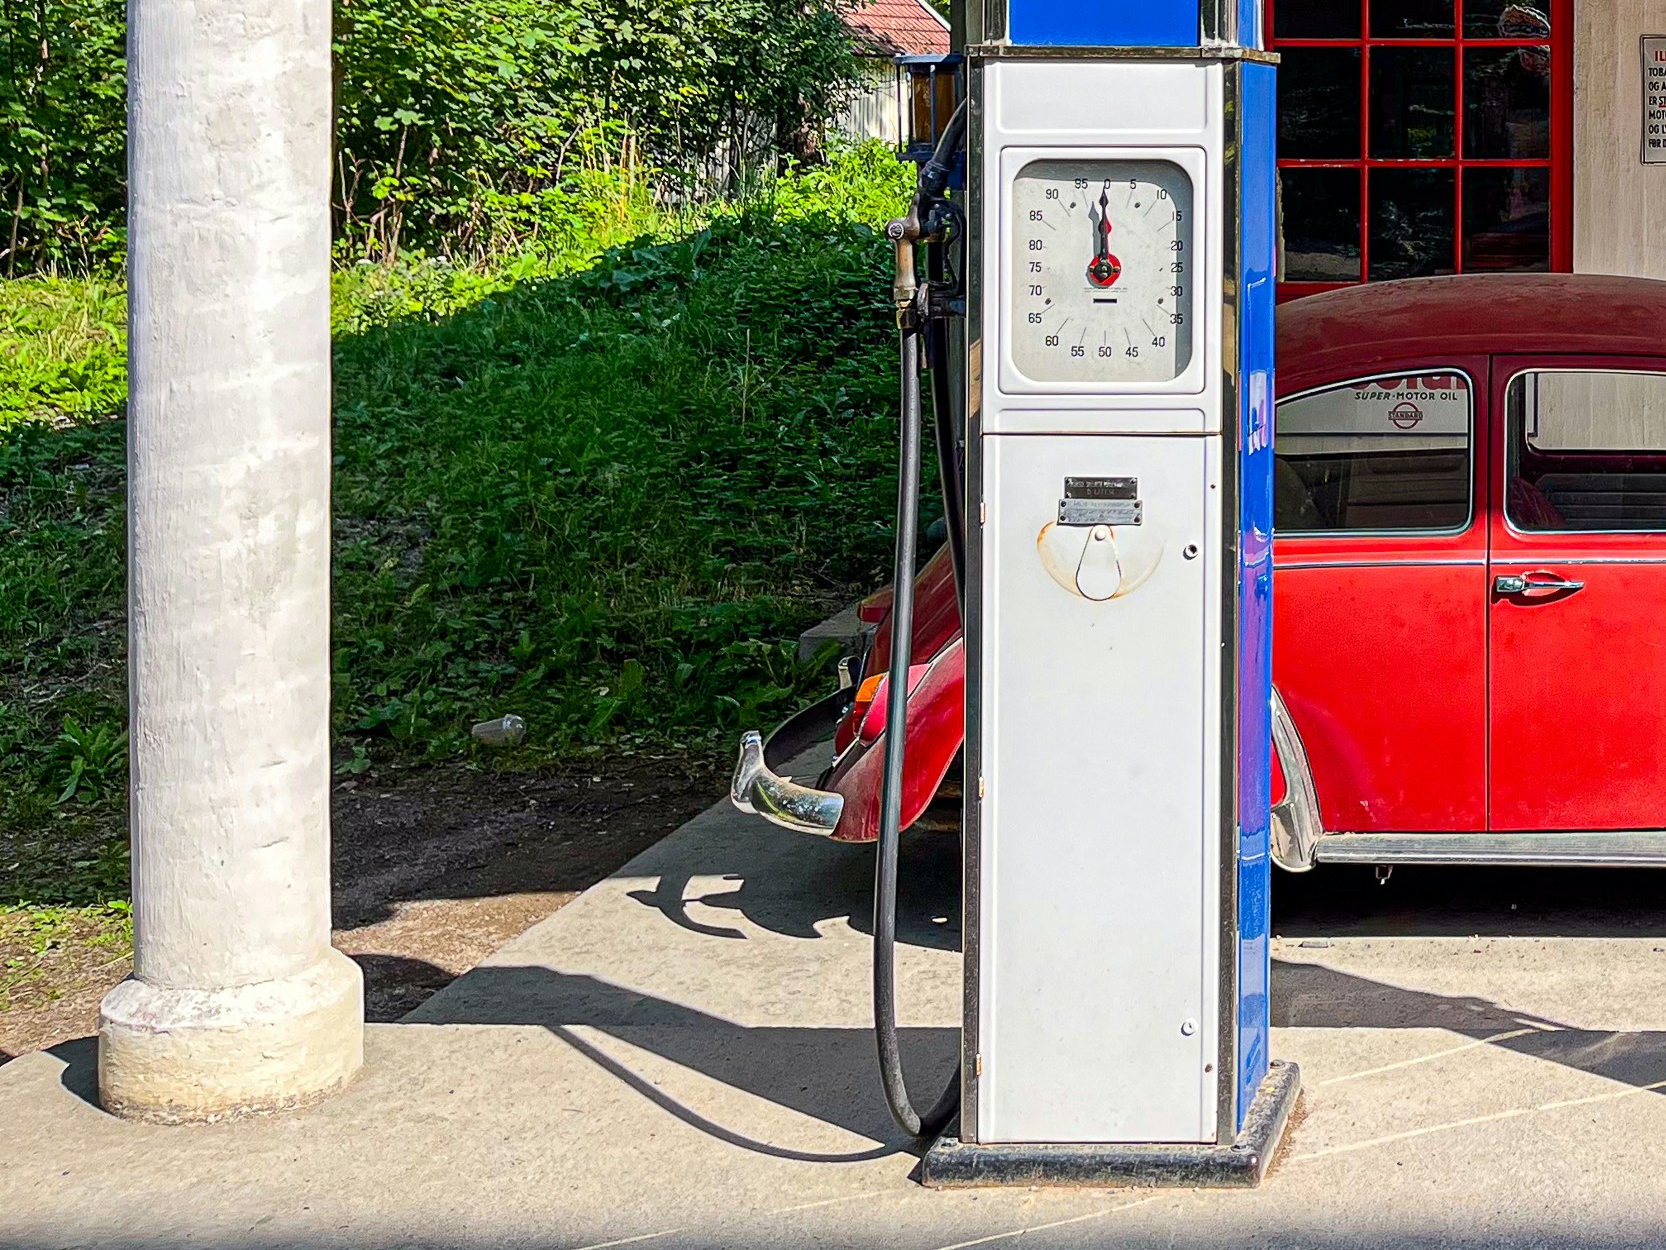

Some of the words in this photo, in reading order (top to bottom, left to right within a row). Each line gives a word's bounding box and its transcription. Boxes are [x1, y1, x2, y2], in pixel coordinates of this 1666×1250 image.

[1648, 81, 1659, 91] OG
[1648, 96, 1658, 105] ER
[1648, 124, 1659, 134] OG
[1104, 179, 1111, 189] 0
[1130, 179, 1137, 189] 5
[1045, 189, 1059, 199] 90
[1157, 189, 1167, 200] 10
[1029, 211, 1043, 221] 85
[1172, 211, 1182, 222] 15
[1029, 240, 1043, 250] 80
[1170, 240, 1183, 251] 20
[1029, 262, 1042, 272] 75
[1170, 262, 1183, 272] 25
[1029, 286, 1042, 296] 70
[1170, 286, 1183, 296] 30
[1028, 313, 1042, 323] 65
[1170, 314, 1183, 324] 35
[1045, 336, 1059, 347] 60
[1152, 337, 1166, 348] 40
[1071, 346, 1085, 357] 55
[1098, 347, 1112, 357] 50
[1125, 347, 1139, 357] 45
[1440, 392, 1457, 400] OIL
